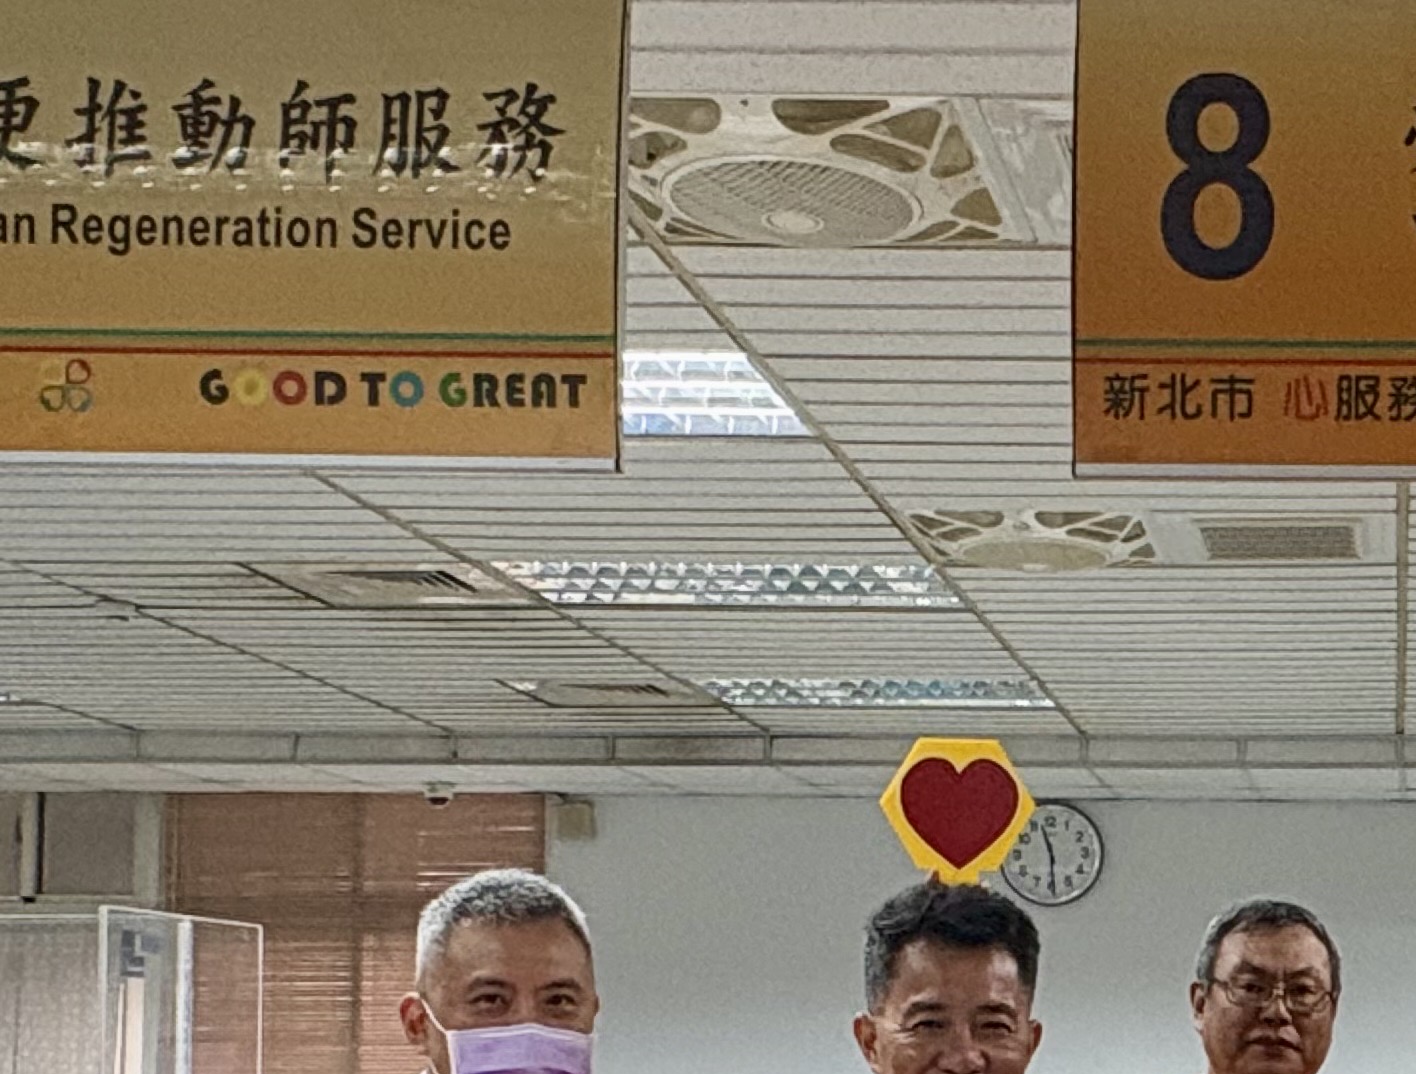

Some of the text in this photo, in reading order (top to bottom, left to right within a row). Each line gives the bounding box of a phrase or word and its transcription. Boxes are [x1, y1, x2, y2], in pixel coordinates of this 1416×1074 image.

[1160, 72, 1275, 281] 8
[51, 203, 337, 256] Regeneration
[352, 208, 511, 250] Service
[200, 368, 587, 408] GOOD TO GREAT
[1103, 372, 1255, 422] 新北市
[1076, 832, 1084, 842] 2
